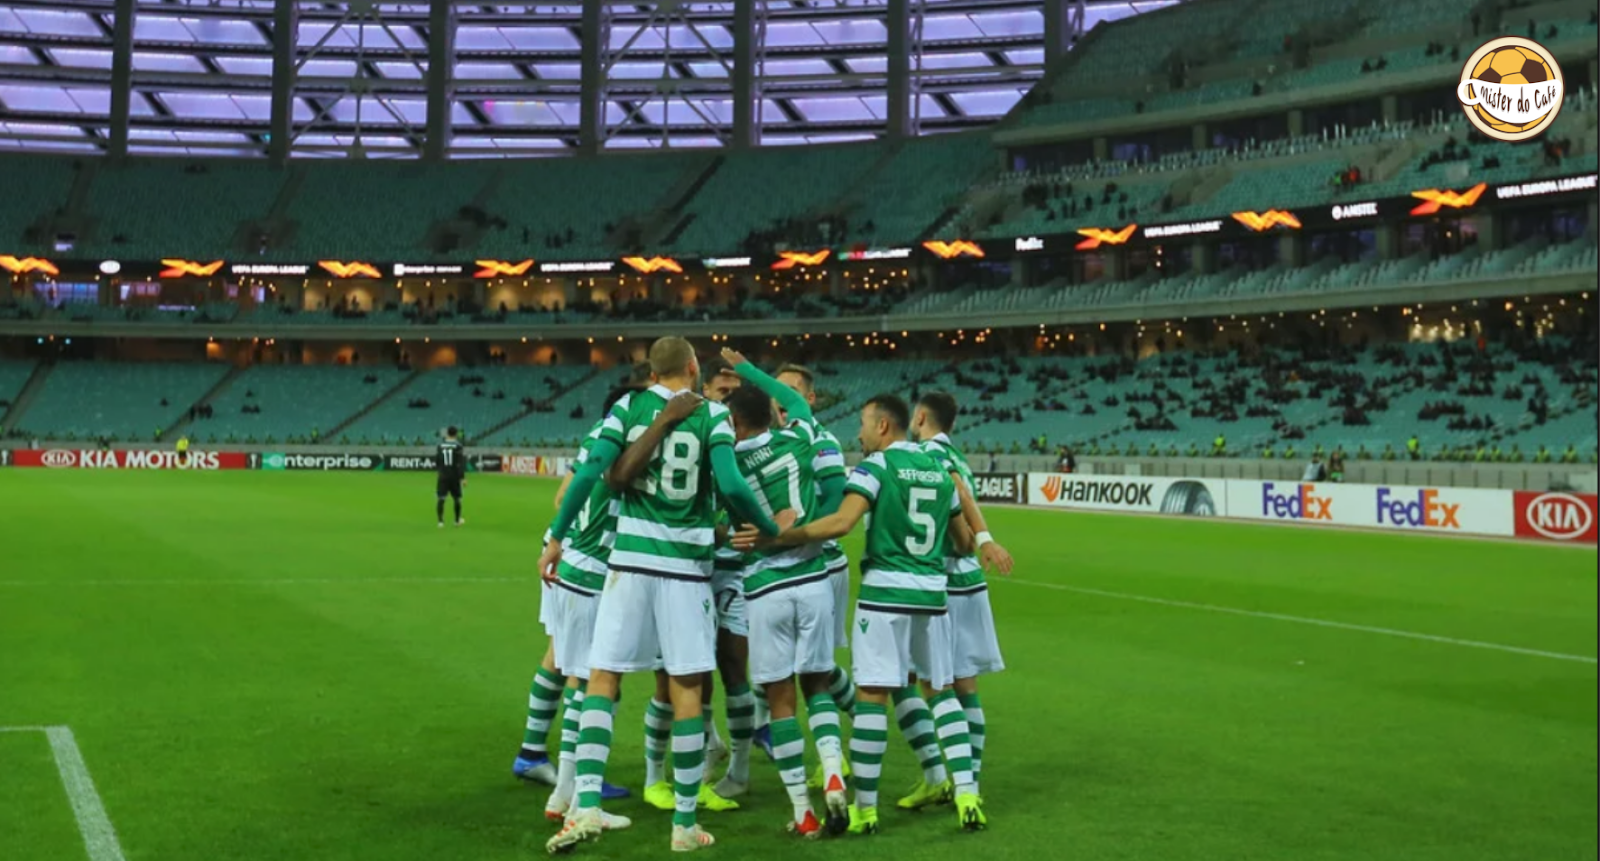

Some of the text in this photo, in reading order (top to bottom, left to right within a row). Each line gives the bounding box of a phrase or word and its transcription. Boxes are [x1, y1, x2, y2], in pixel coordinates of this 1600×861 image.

[1522, 181, 1558, 196] EUROPA
[1558, 175, 1597, 191] LEAGUE
[80, 450, 220, 469] KIA MOTORS
[269, 453, 373, 471] enterprise
[390, 457, 437, 469] RENT-A-
[442, 448, 453, 466] 11
[743, 446, 774, 469] NANI
[975, 475, 1014, 498] EAGUE
[1262, 482, 1333, 520] FedEx
[1376, 487, 1460, 529] FedEx
[904, 486, 938, 556] 5
[1537, 502, 1581, 530] KIA
